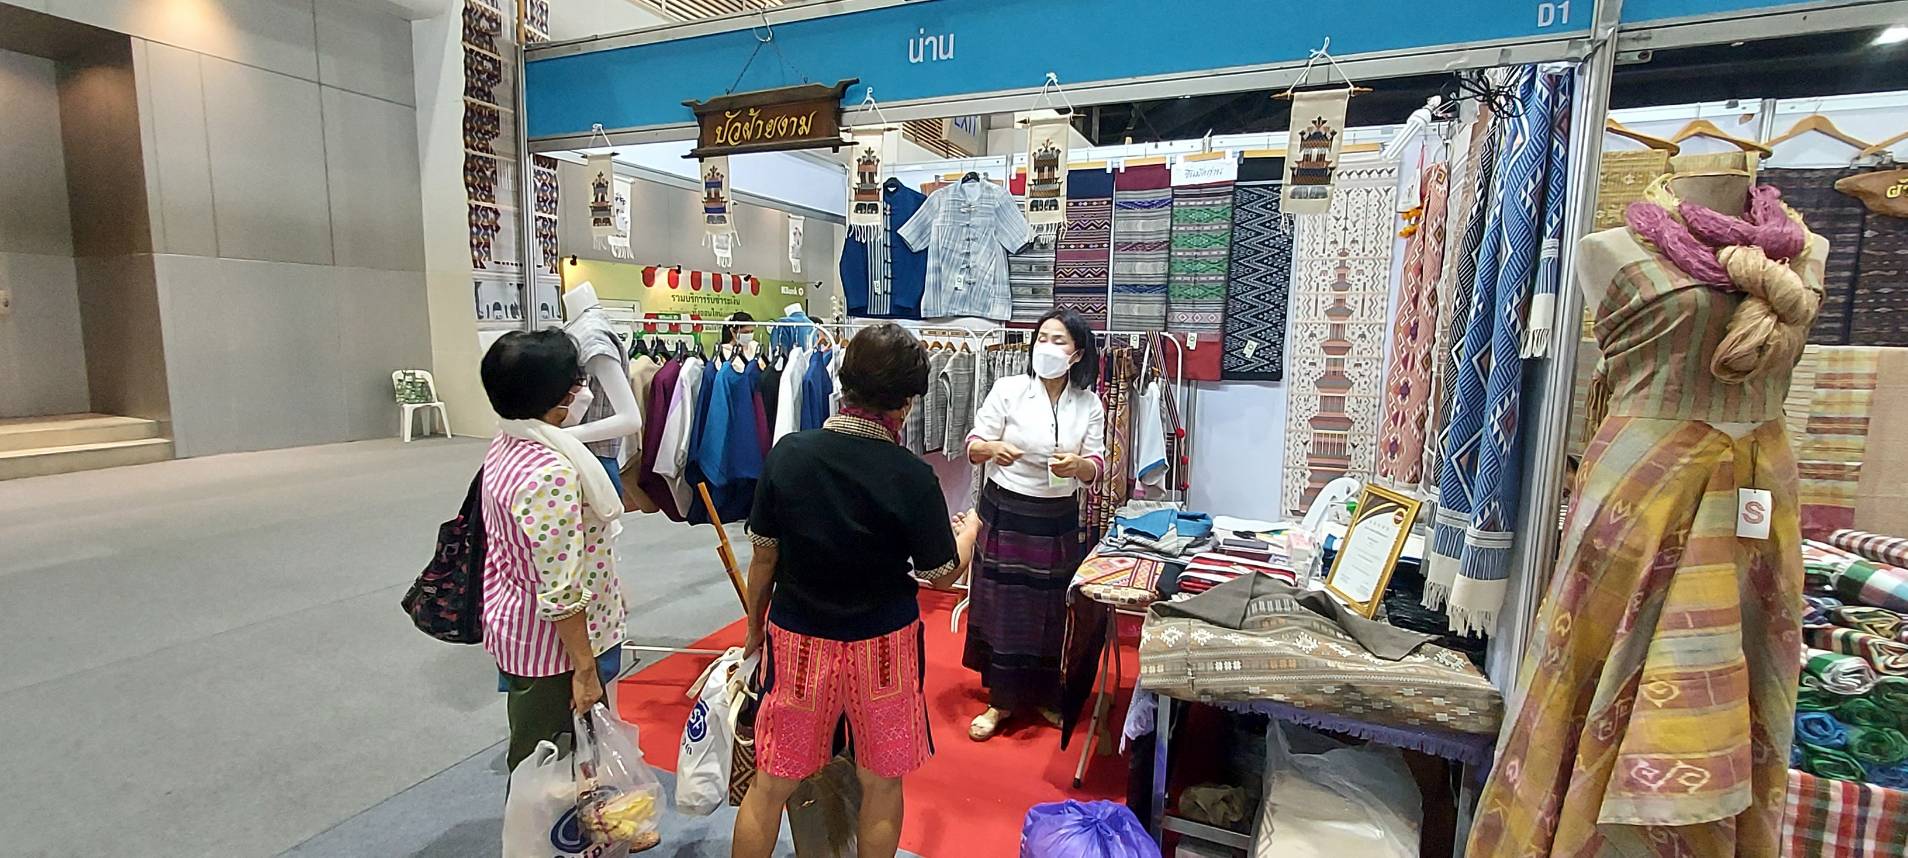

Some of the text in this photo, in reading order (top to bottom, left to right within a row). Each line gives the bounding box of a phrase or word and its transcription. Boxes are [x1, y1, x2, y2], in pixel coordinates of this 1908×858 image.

[1537, 1, 1569, 28] D1
[908, 27, 955, 64] น่าน
[1741, 500, 1766, 525] S
